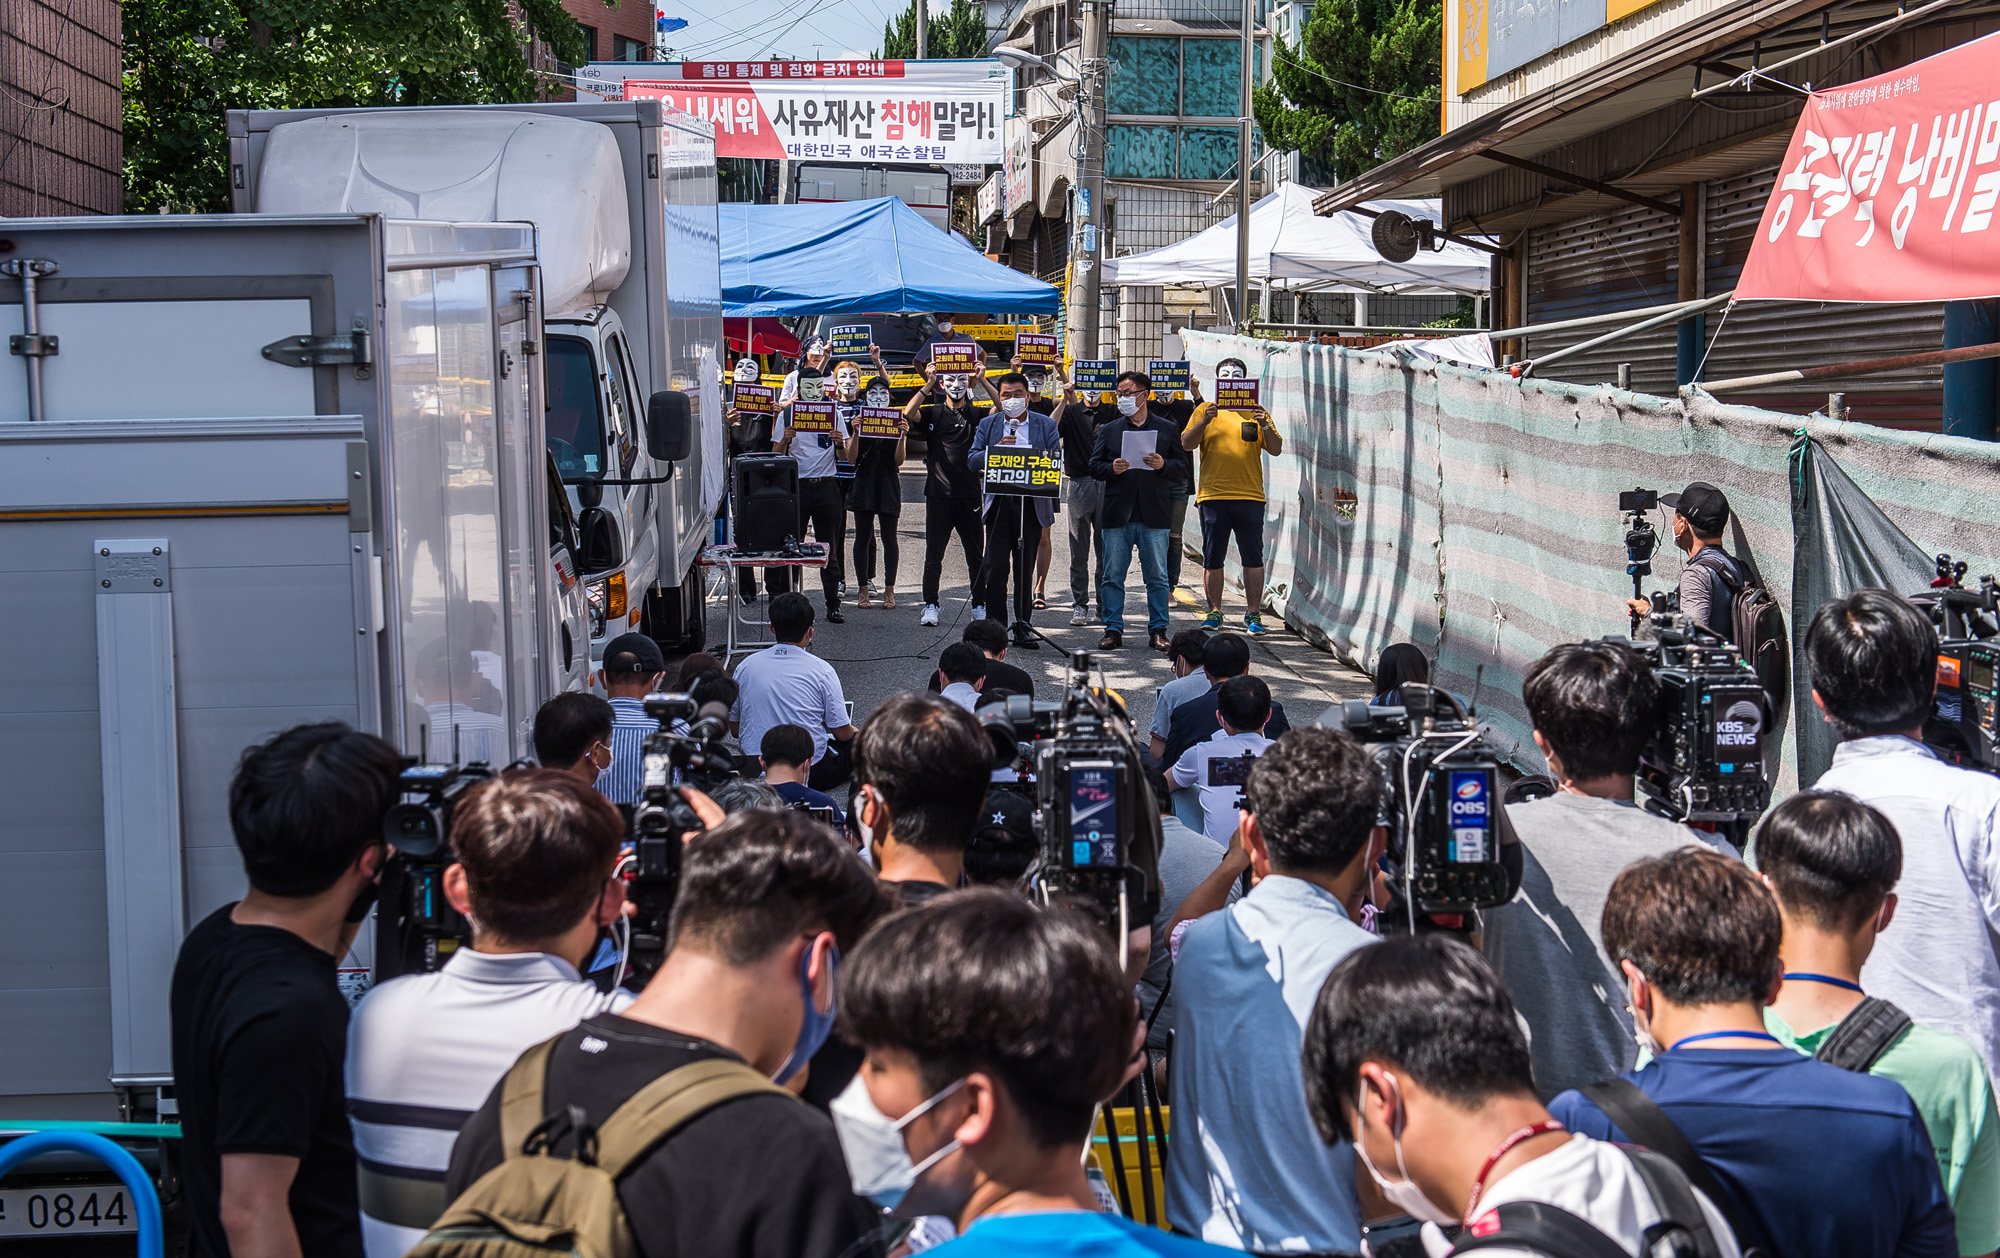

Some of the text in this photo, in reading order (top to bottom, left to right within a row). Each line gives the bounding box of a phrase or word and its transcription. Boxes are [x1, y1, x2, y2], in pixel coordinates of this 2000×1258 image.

[702, 62, 885, 78] 출입 통제 및 집회 금지 안내
[773, 99, 876, 140] 사유재산
[787, 143, 947, 160] 대한민국 애국순찰팀
[1768, 125, 1897, 248] 공권력
[988, 454, 1061, 469] 문재인 구속이
[986, 468, 1060, 485] 최고의 방역
[1716, 721, 1744, 733] KBS
[1716, 733, 1757, 745] NEWS
[1452, 801, 1486, 814] OBS
[28, 1191, 128, 1229] 0844
